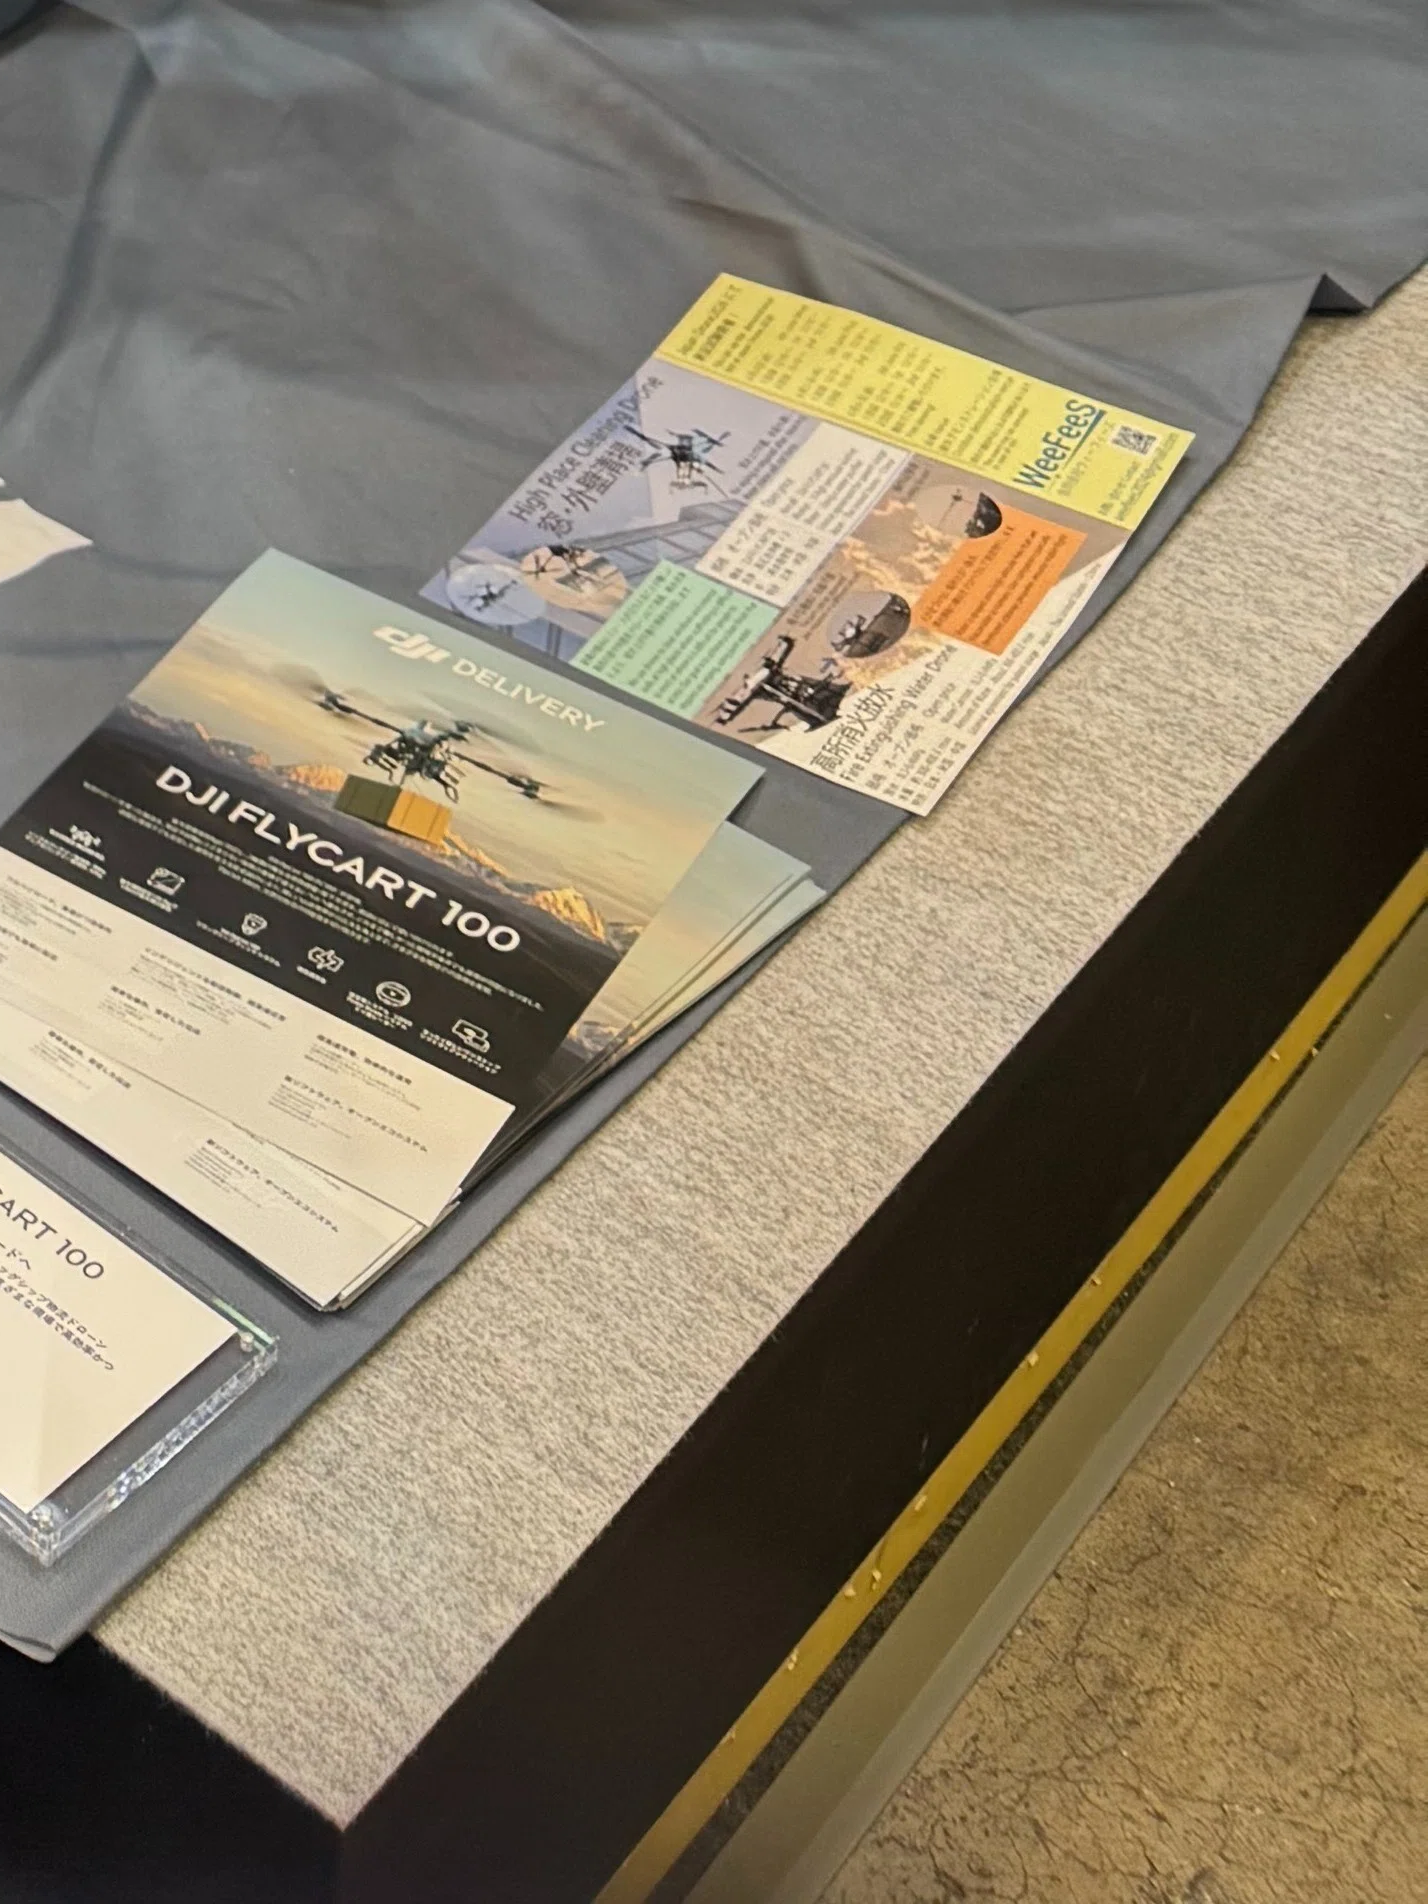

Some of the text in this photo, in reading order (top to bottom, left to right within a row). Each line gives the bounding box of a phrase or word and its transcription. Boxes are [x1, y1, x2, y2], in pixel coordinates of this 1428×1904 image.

[504, 485, 557, 524] High
[535, 453, 583, 490] Place
[567, 406, 636, 461] Cleaning
[1011, 397, 1100, 492] WeeFeeS
[448, 657, 606, 735] DELIVERY
[152, 765, 526, 956] DJI FLYCART 100
[52, 1238, 109, 1283] 100
